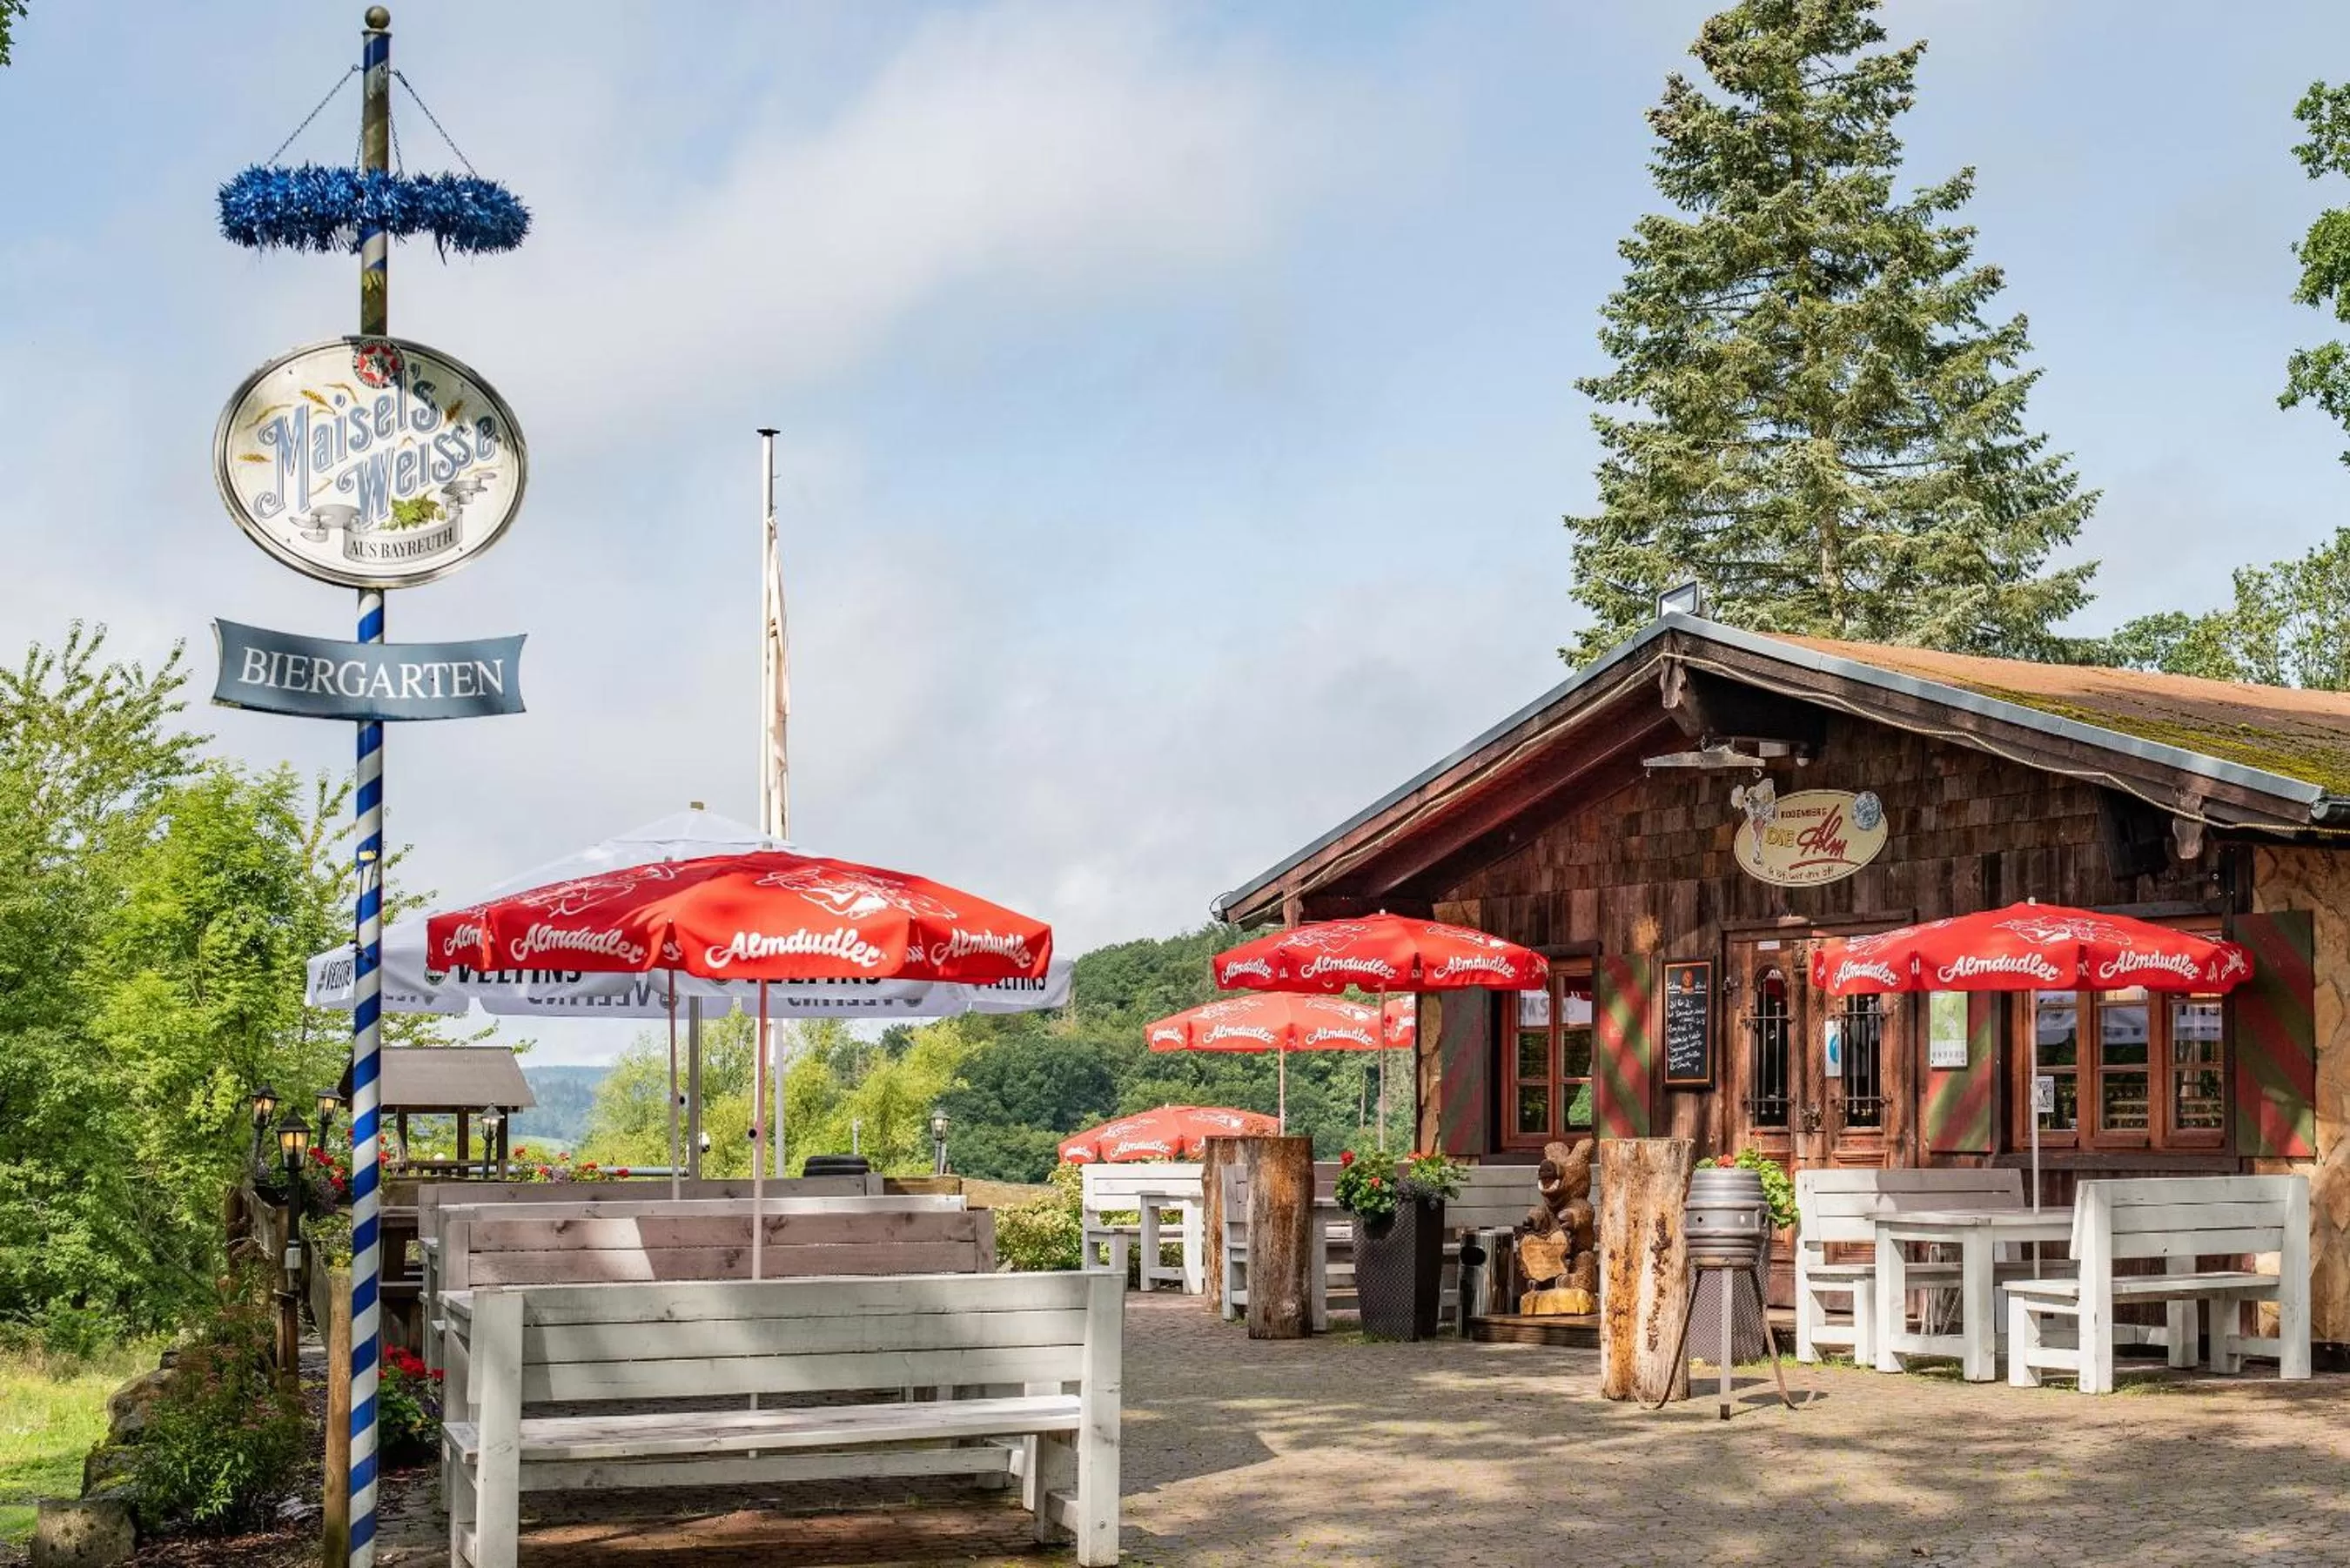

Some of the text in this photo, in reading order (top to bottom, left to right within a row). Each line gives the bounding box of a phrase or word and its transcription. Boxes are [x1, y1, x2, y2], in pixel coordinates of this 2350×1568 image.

[252, 362, 442, 519] Maisel's
[336, 414, 501, 526] Weisse
[349, 526, 453, 559] AUS BAYREUTH
[238, 647, 504, 699] BIERGARTEN
[1765, 827, 1795, 848] DIE
[510, 923, 645, 963] Almdudler
[705, 927, 882, 969] Almdudler
[930, 928, 1032, 969] Almdudler
[1300, 955, 1396, 979] Almdudler
[1434, 954, 1516, 979] Almdudler
[1937, 952, 2059, 983] Almdudler
[2098, 950, 2200, 980] Almdudler
